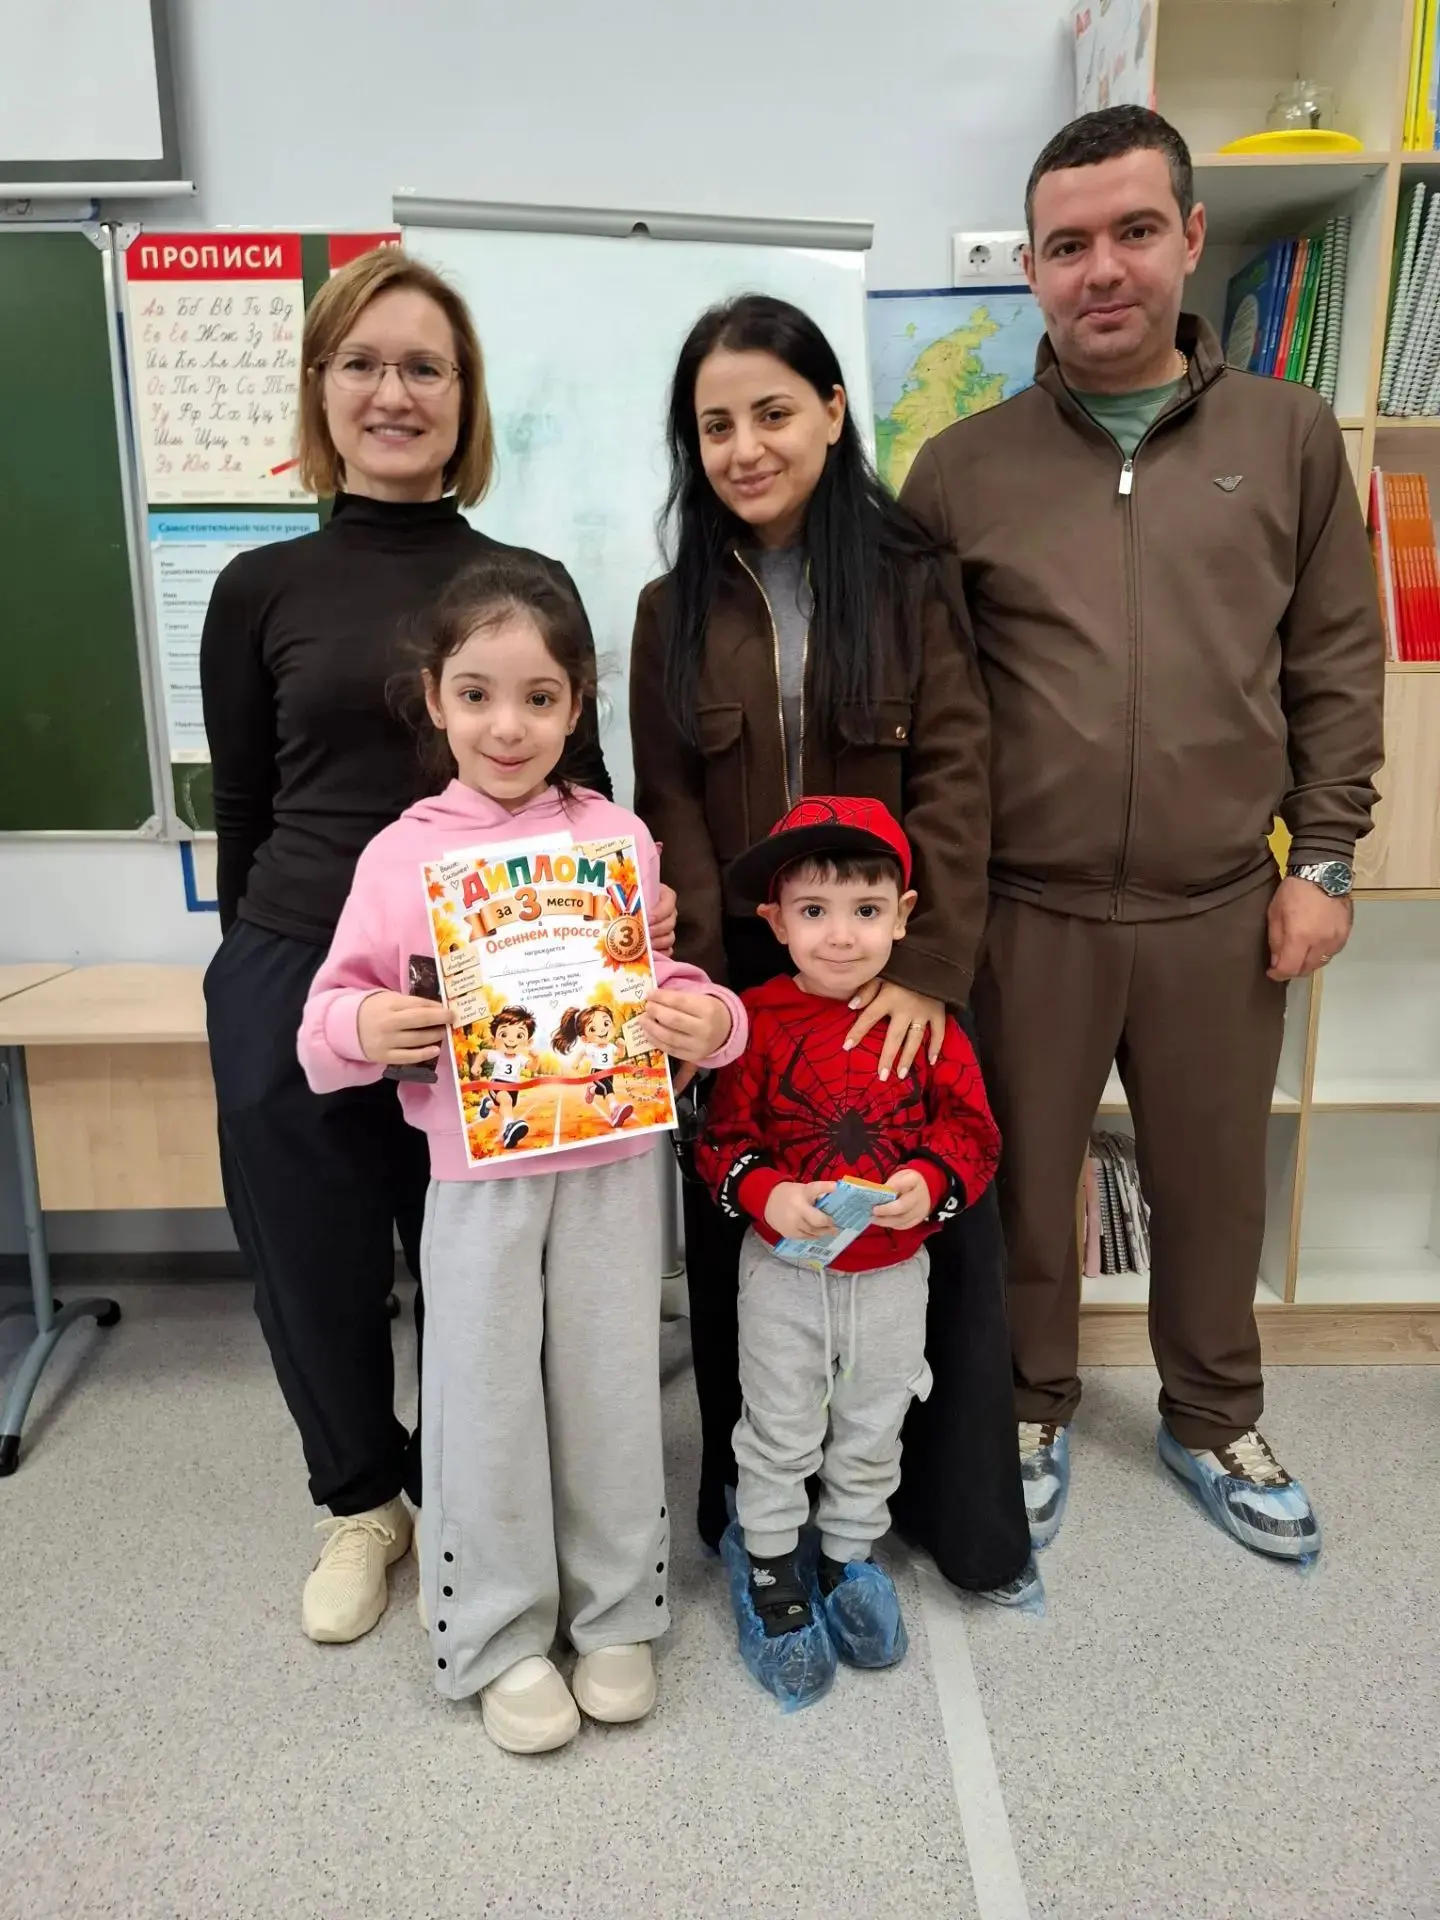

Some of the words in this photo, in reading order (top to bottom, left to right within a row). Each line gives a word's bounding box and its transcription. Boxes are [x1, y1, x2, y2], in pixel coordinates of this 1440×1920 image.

[141, 245, 283, 269] ПРОПИСИ
[461, 855, 606, 909] ДИПЛОМ
[496, 905, 512, 918] за
[515, 887, 542, 921] 3
[547, 897, 584, 908] место
[486, 928, 549, 953] Осеннем
[553, 927, 600, 940] кроссе
[619, 925, 634, 947] 3
[524, 946, 565, 957] награждается
[504, 1064, 512, 1074] 3
[601, 1053, 608, 1063] 3
